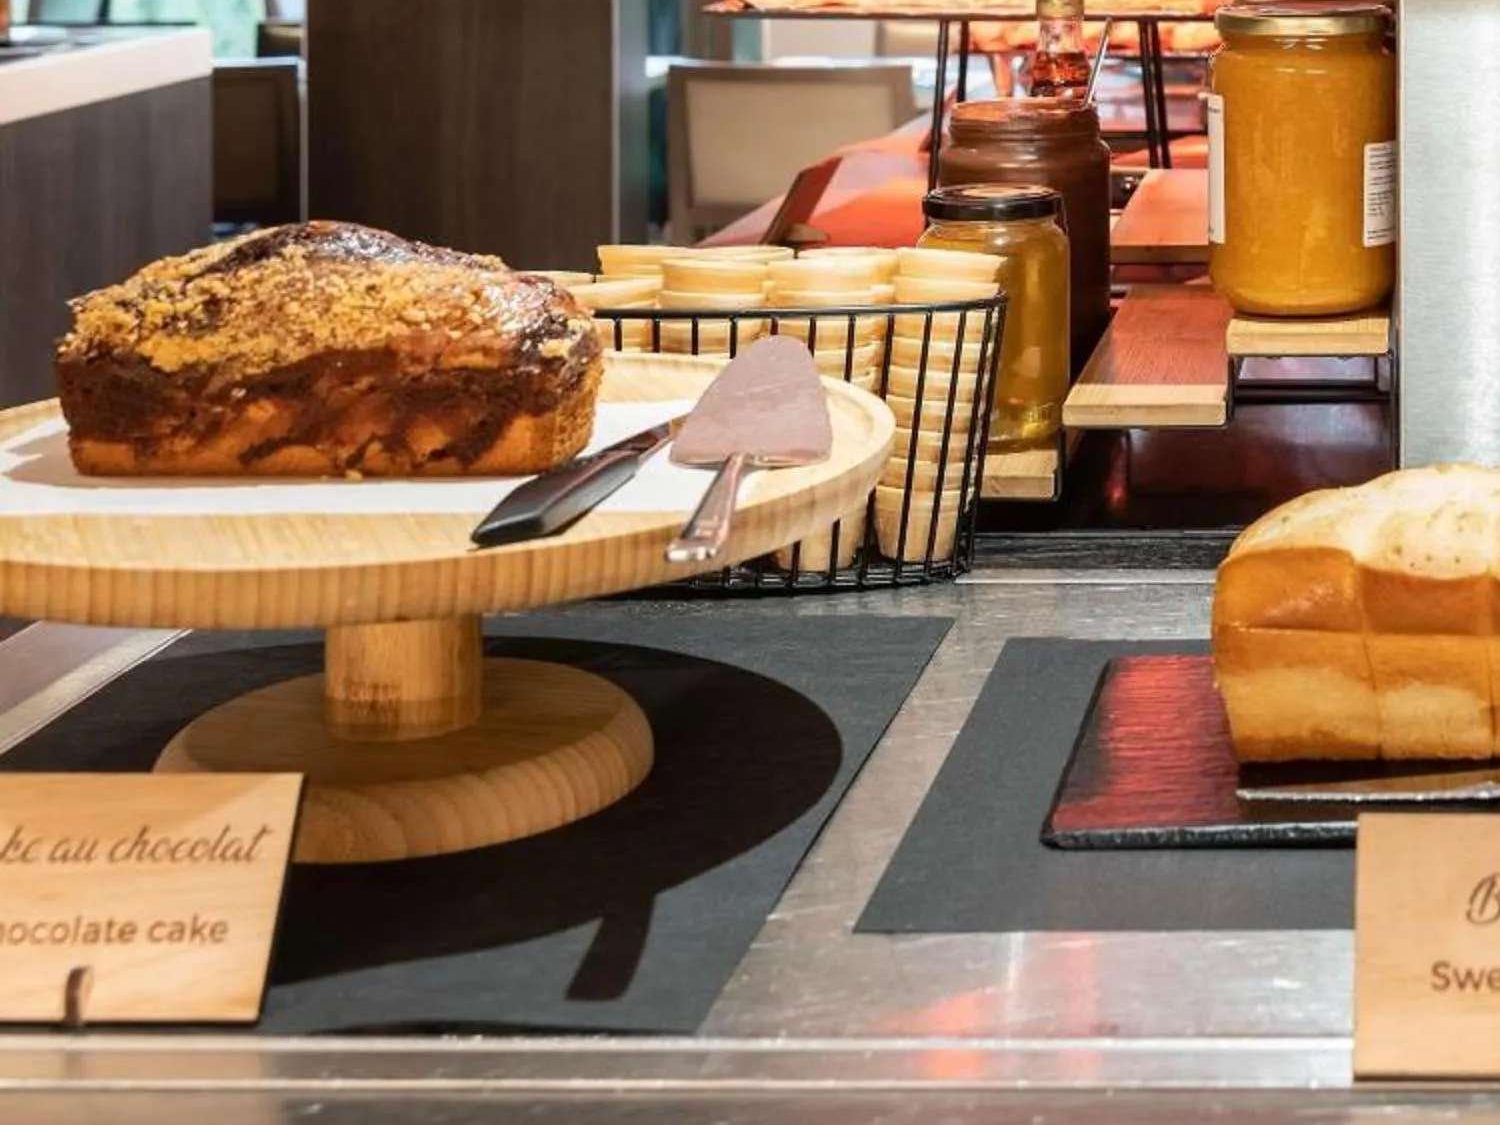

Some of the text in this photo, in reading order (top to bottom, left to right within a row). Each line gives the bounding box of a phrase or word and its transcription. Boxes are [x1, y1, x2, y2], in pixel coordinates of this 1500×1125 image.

[48, 836, 98, 864] au
[108, 825, 275, 864] chocolat
[146, 914, 229, 944] cake
